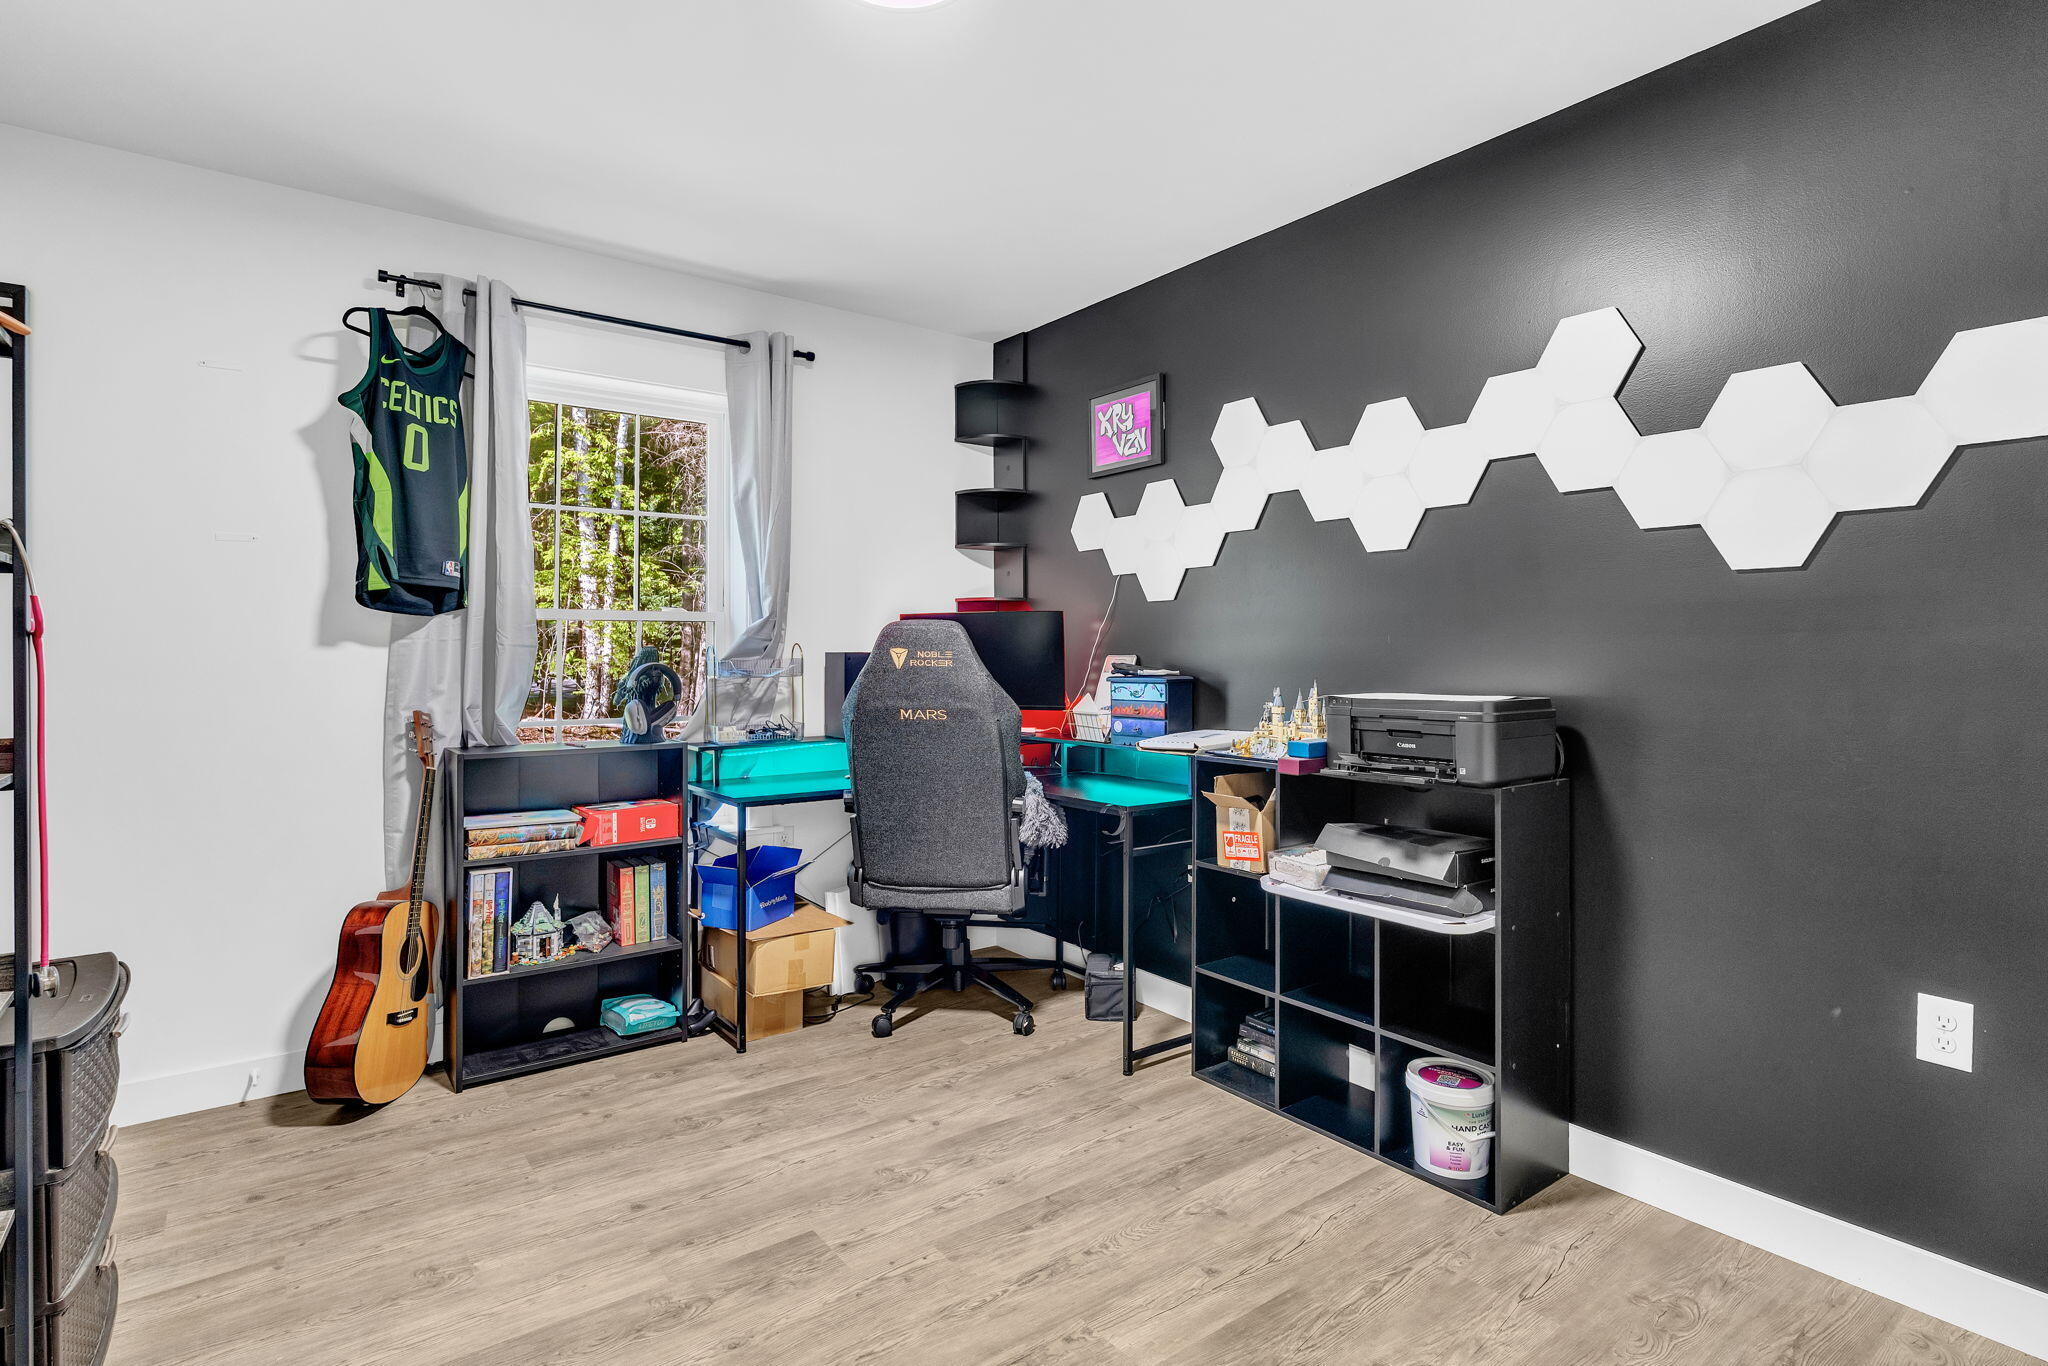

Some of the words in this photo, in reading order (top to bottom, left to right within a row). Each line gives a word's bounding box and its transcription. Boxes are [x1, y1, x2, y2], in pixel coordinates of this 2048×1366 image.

[403, 422, 430, 473] 0
[917, 650, 953, 658] NOBLE
[909, 659, 953, 667] ROCKER
[900, 708, 947, 720] MARS
[1396, 741, 1416, 749] Canon
[1234, 834, 1259, 844] FRAGILE
